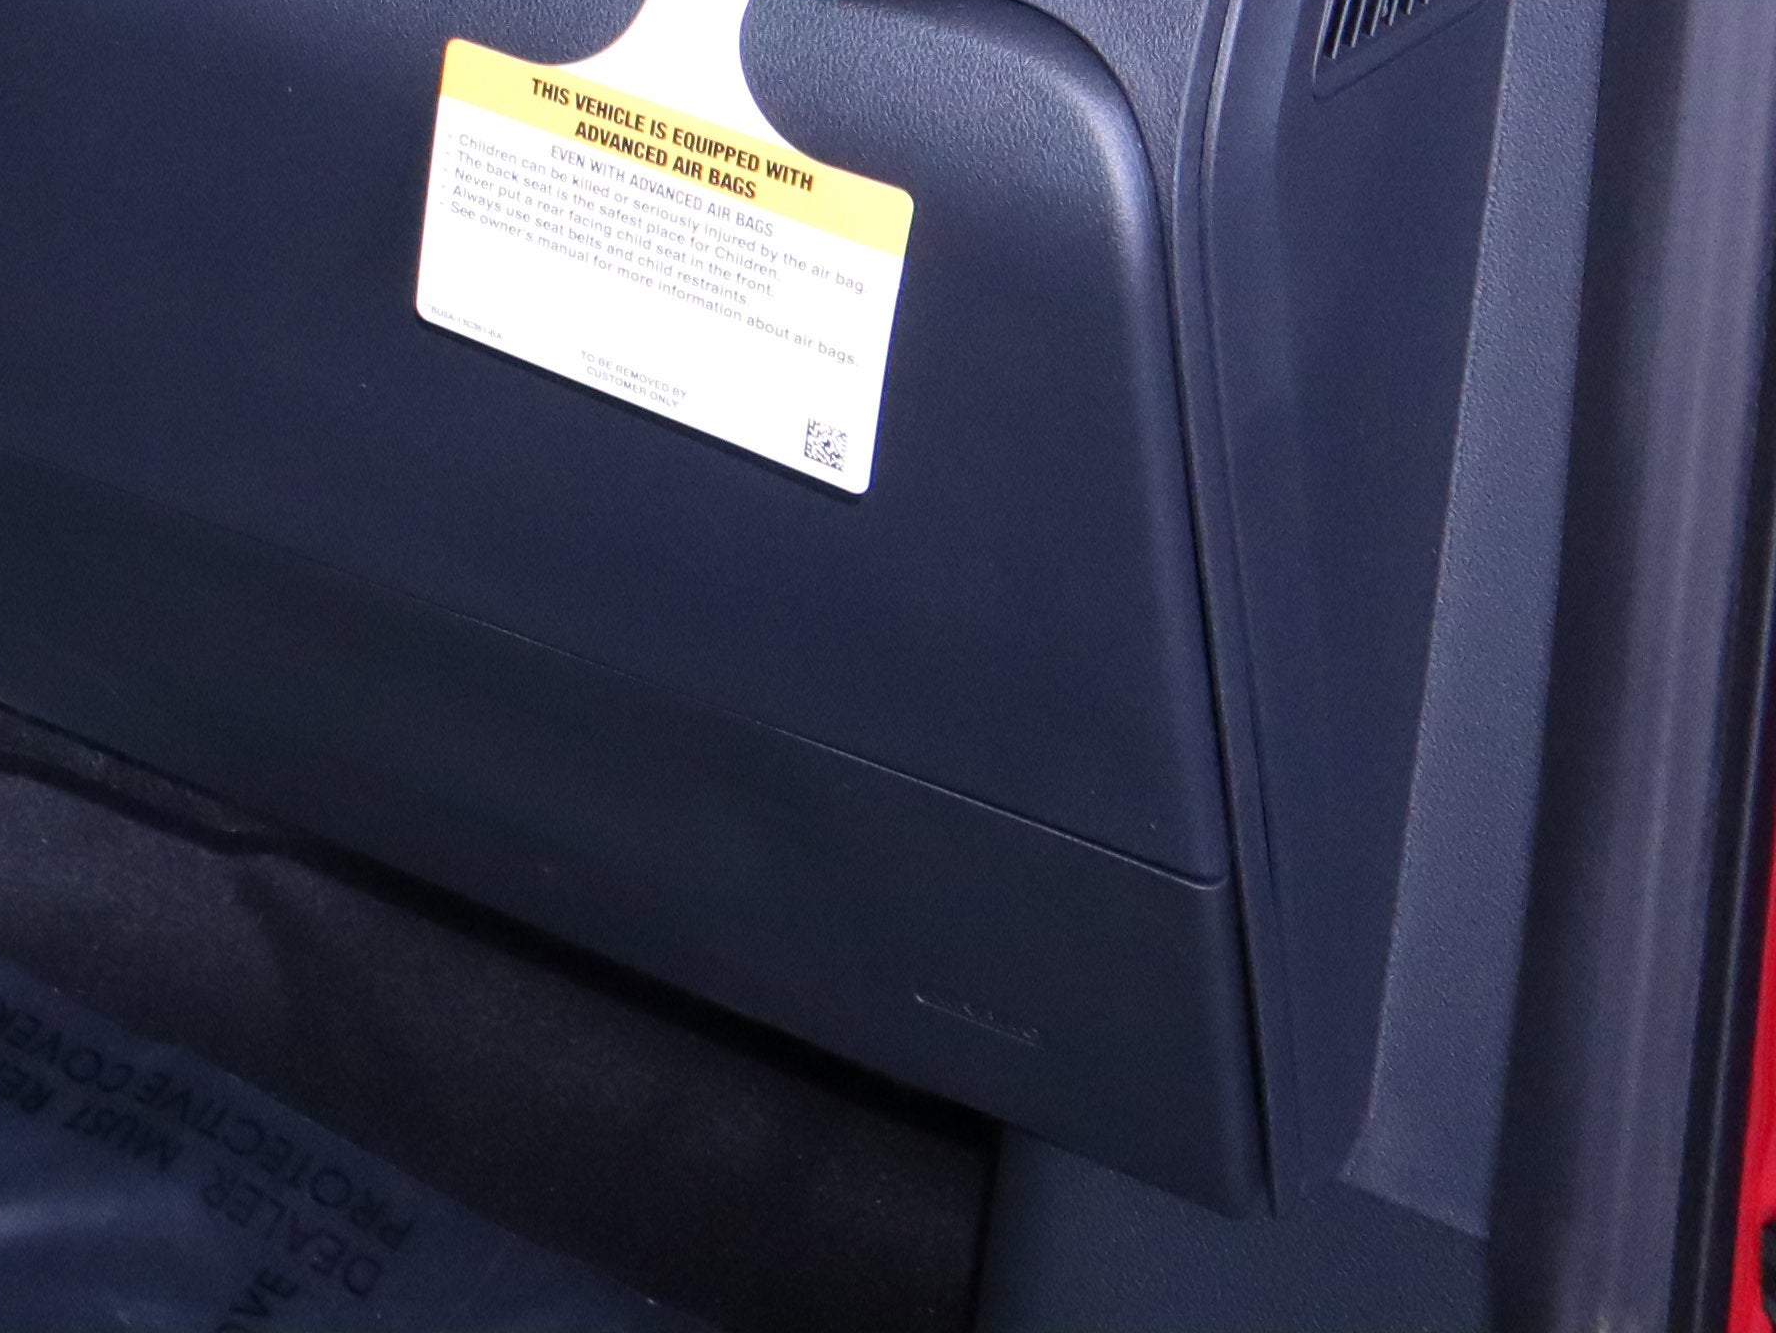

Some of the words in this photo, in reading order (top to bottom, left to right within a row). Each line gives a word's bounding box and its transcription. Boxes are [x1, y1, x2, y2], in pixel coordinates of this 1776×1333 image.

[532, 78, 569, 106] THIS
[575, 93, 644, 131] VEHICLE
[649, 119, 667, 140] IS
[672, 127, 761, 172] EQUIPPED
[766, 160, 814, 192] WITH
[550, 144, 587, 170] EVEN
[590, 158, 627, 184] WITH
[628, 173, 704, 212] ADVANCED
[706, 201, 733, 223] AIR
[735, 211, 775, 239] BAGS
[575, 121, 668, 167] ADVANCED
[672, 156, 703, 181] AIR
[708, 167, 756, 199] BAGS
[451, 183, 503, 215] Always
[505, 204, 533, 224] use
[534, 217, 565, 238] seat
[567, 226, 604, 254] belts
[606, 244, 635, 264] and
[637, 253, 675, 279] child
[453, 166, 496, 193] Never
[497, 185, 522, 204] put
[524, 195, 535, 208] a
[536, 199, 567, 219] rear
[568, 208, 614, 240] facing
[616, 228, 654, 252] child
[655, 244, 688, 266] seat
[690, 253, 705, 272] in
[708, 261, 733, 282] the
[456, 149, 484, 171] The
[486, 160, 521, 186] back
[522, 177, 554, 198] seat
[556, 186, 570, 203] is
[572, 192, 596, 215] the
[598, 204, 644, 231] safest
[645, 222, 687, 247] place
[689, 235, 712, 255] for
[458, 133, 519, 167] Children
[520, 158, 548, 177] can
[550, 165, 569, 184] be
[571, 174, 612, 201] killed
[613, 189, 631, 207] or
[632, 197, 702, 236] seriously
[704, 222, 758, 256] injured
[759, 242, 780, 265] by
[783, 252, 810, 273] the
[810, 263, 832, 281] air
[449, 200, 477, 222] See
[537, 235, 591, 265] manual
[593, 254, 615, 273] for
[616, 265, 656, 289] more
[657, 278, 744, 324] information
[746, 316, 792, 342] about
[793, 332, 816, 350] air
[61, 1104, 184, 1172] MUST
[135, 1071, 417, 1252] PROTECTIVE
[201, 1164, 382, 1299] DEALER
